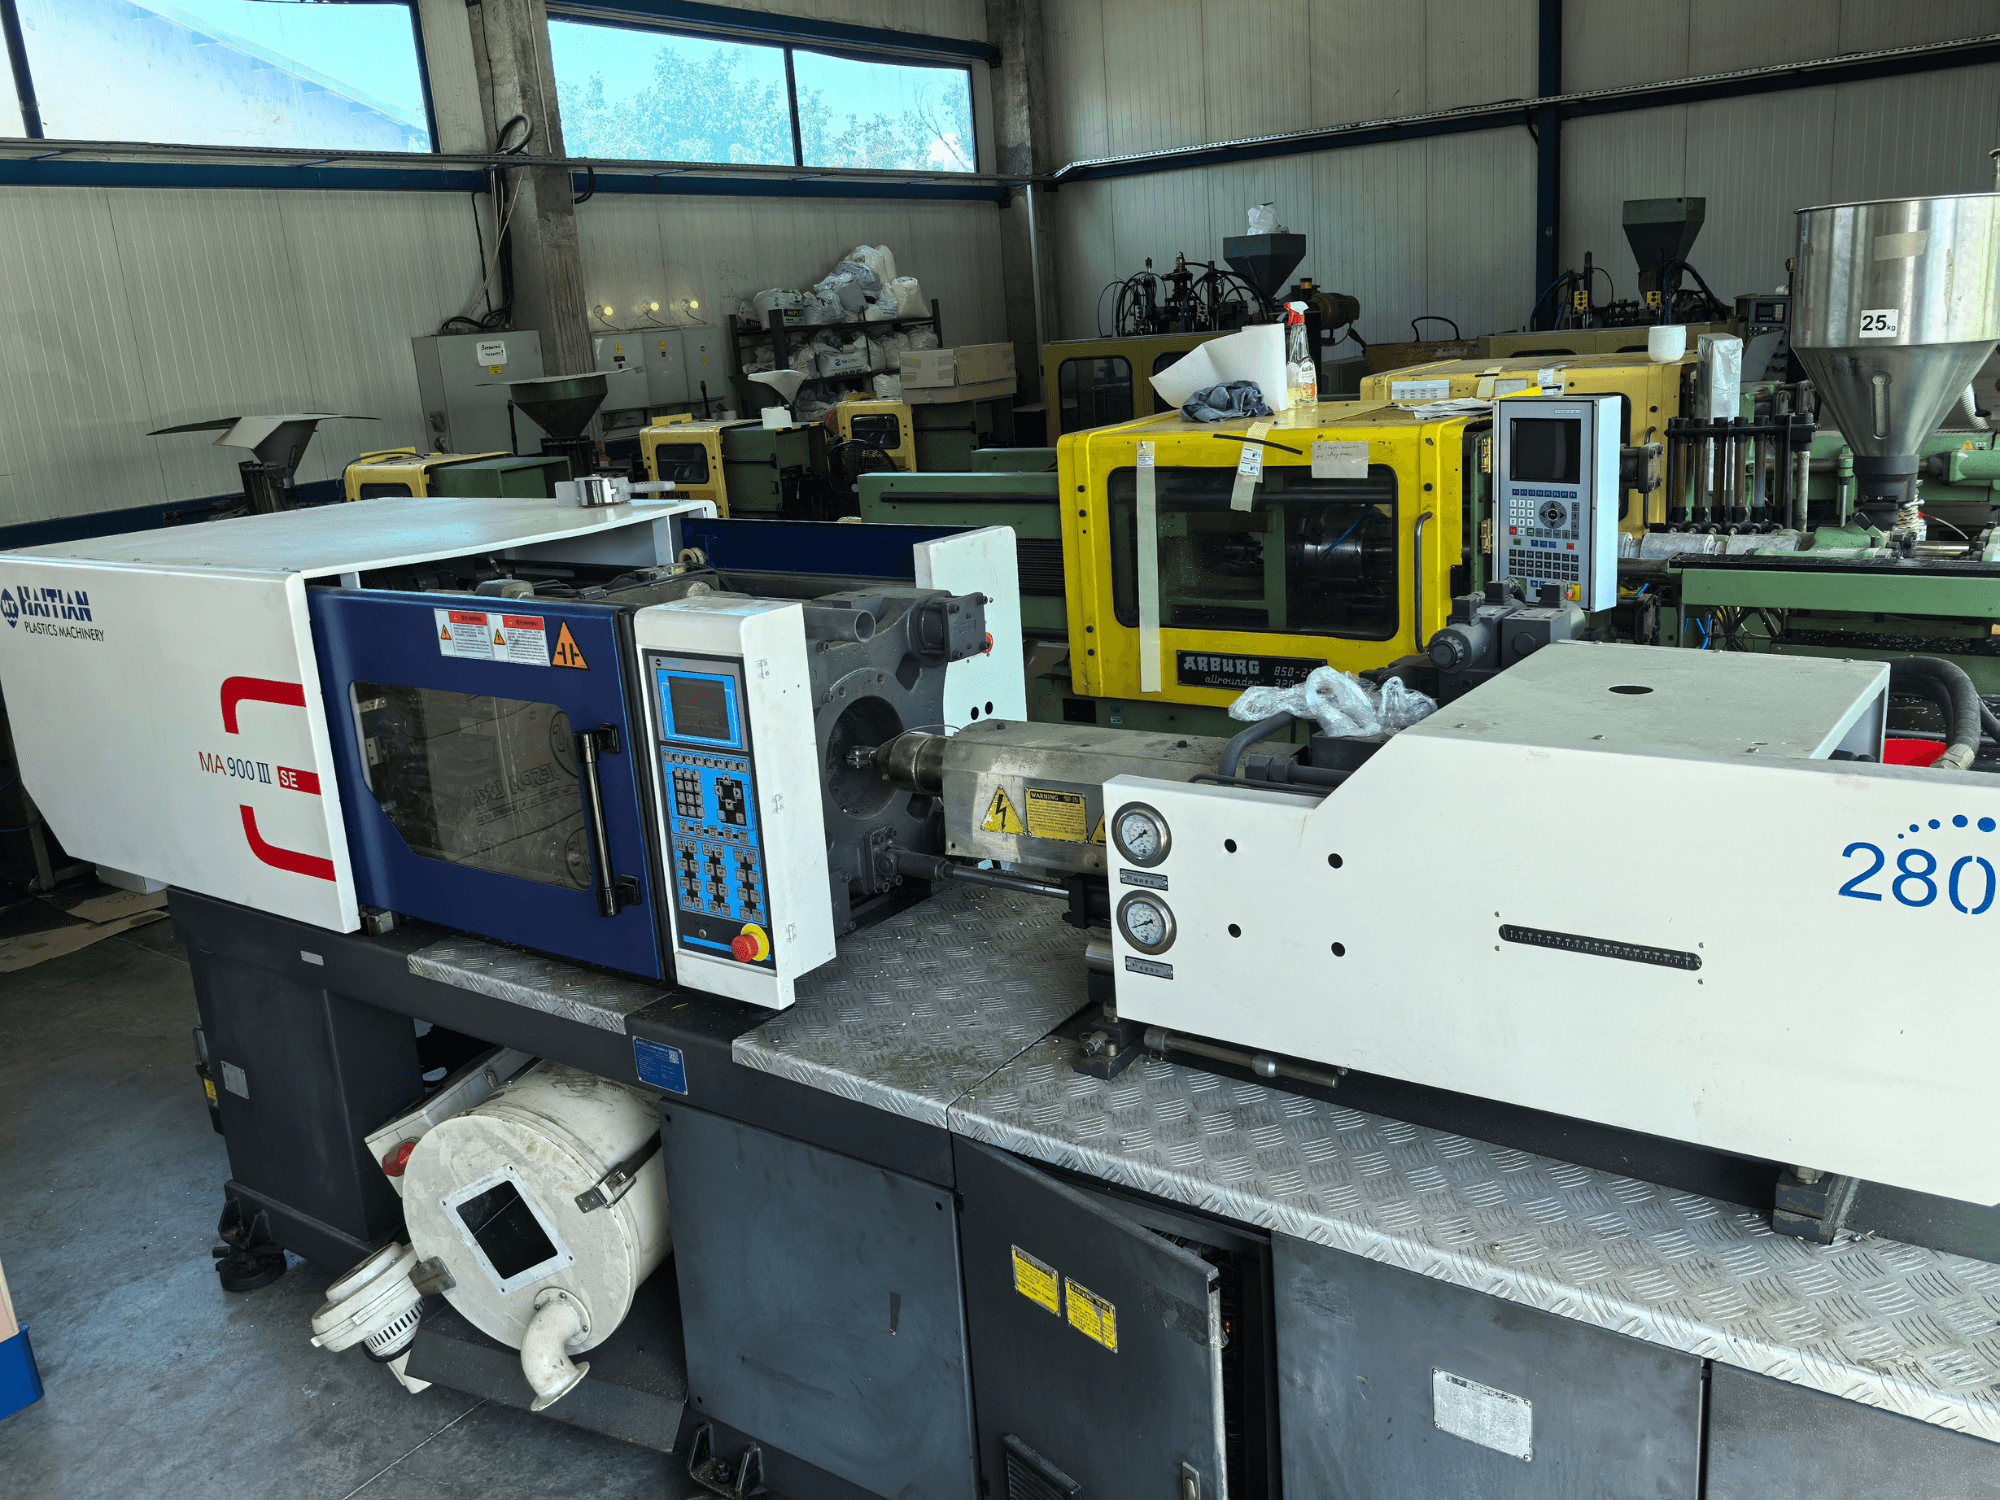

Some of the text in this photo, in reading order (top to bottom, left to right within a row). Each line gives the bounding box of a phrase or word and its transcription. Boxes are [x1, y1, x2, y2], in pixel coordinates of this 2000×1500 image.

[1862, 314, 1886, 331] 25
[16, 586, 92, 622] HAITIAN
[24, 621, 104, 641] PLASTICS MACHINERY
[1184, 656, 1313, 678] ARBURG 850-2
[280, 770, 298, 788] SE
[1030, 792, 1058, 800] WARNING
[1838, 842, 1996, 914] 280
